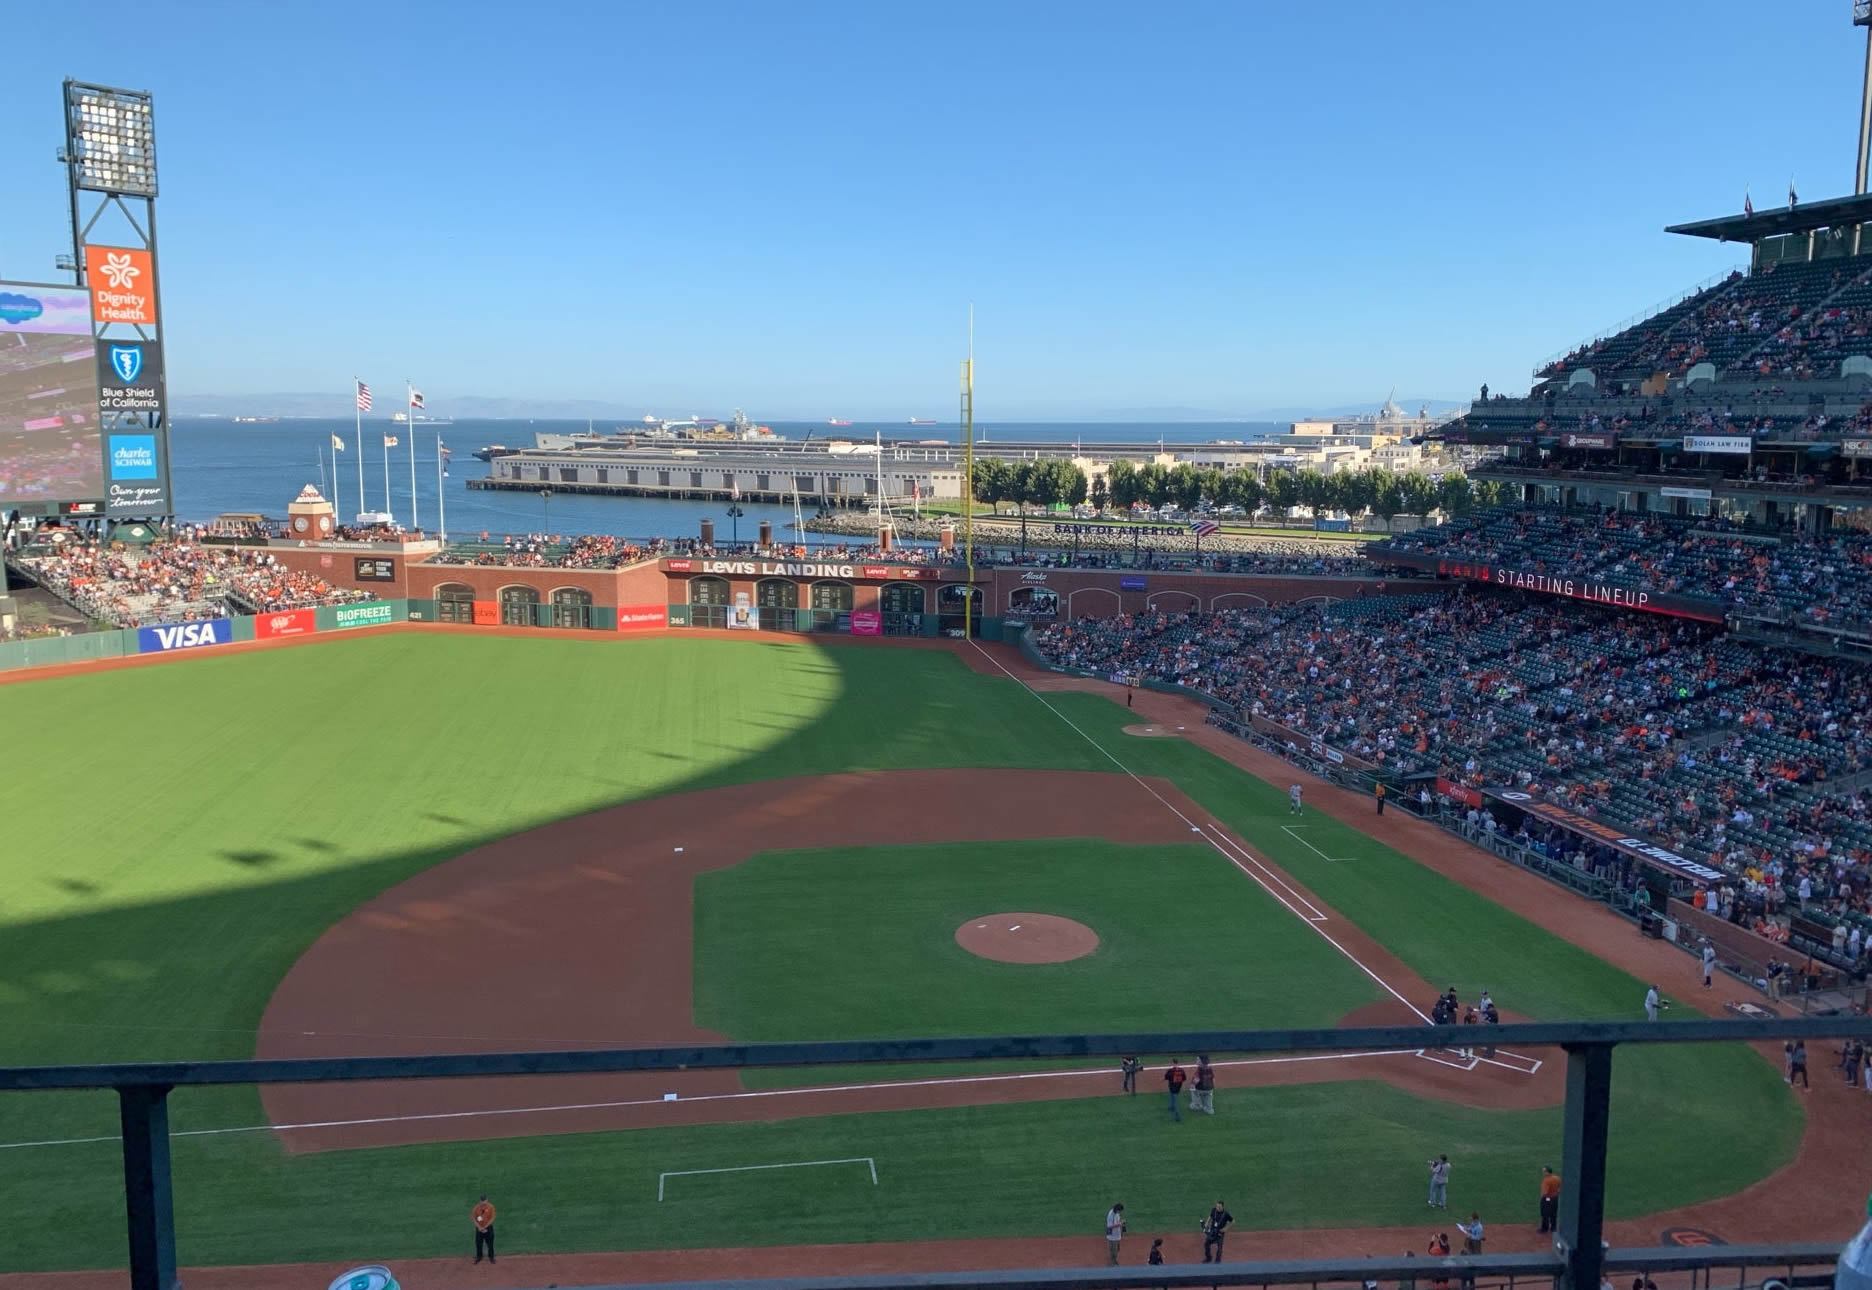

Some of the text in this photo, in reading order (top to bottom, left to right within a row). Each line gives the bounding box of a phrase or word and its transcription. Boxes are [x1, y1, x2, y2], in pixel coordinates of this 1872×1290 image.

[98, 290, 145, 308] Dignity
[102, 387, 154, 397] Blue Shield
[100, 397, 158, 407] of California
[114, 447, 151, 458] charles
[114, 458, 152, 466] SCHWAB
[110, 484, 161, 500] Own your
[1054, 524, 1185, 536] BANK OF AMERICA
[762, 562, 854, 577] LANDING
[1020, 571, 1047, 580] Alaska
[1498, 569, 1574, 595] STARTING
[1584, 583, 1648, 608] LINEUP
[152, 623, 216, 649] VISA
[950, 629, 966, 637] 309
[1638, 846, 1727, 879] WELCOME
